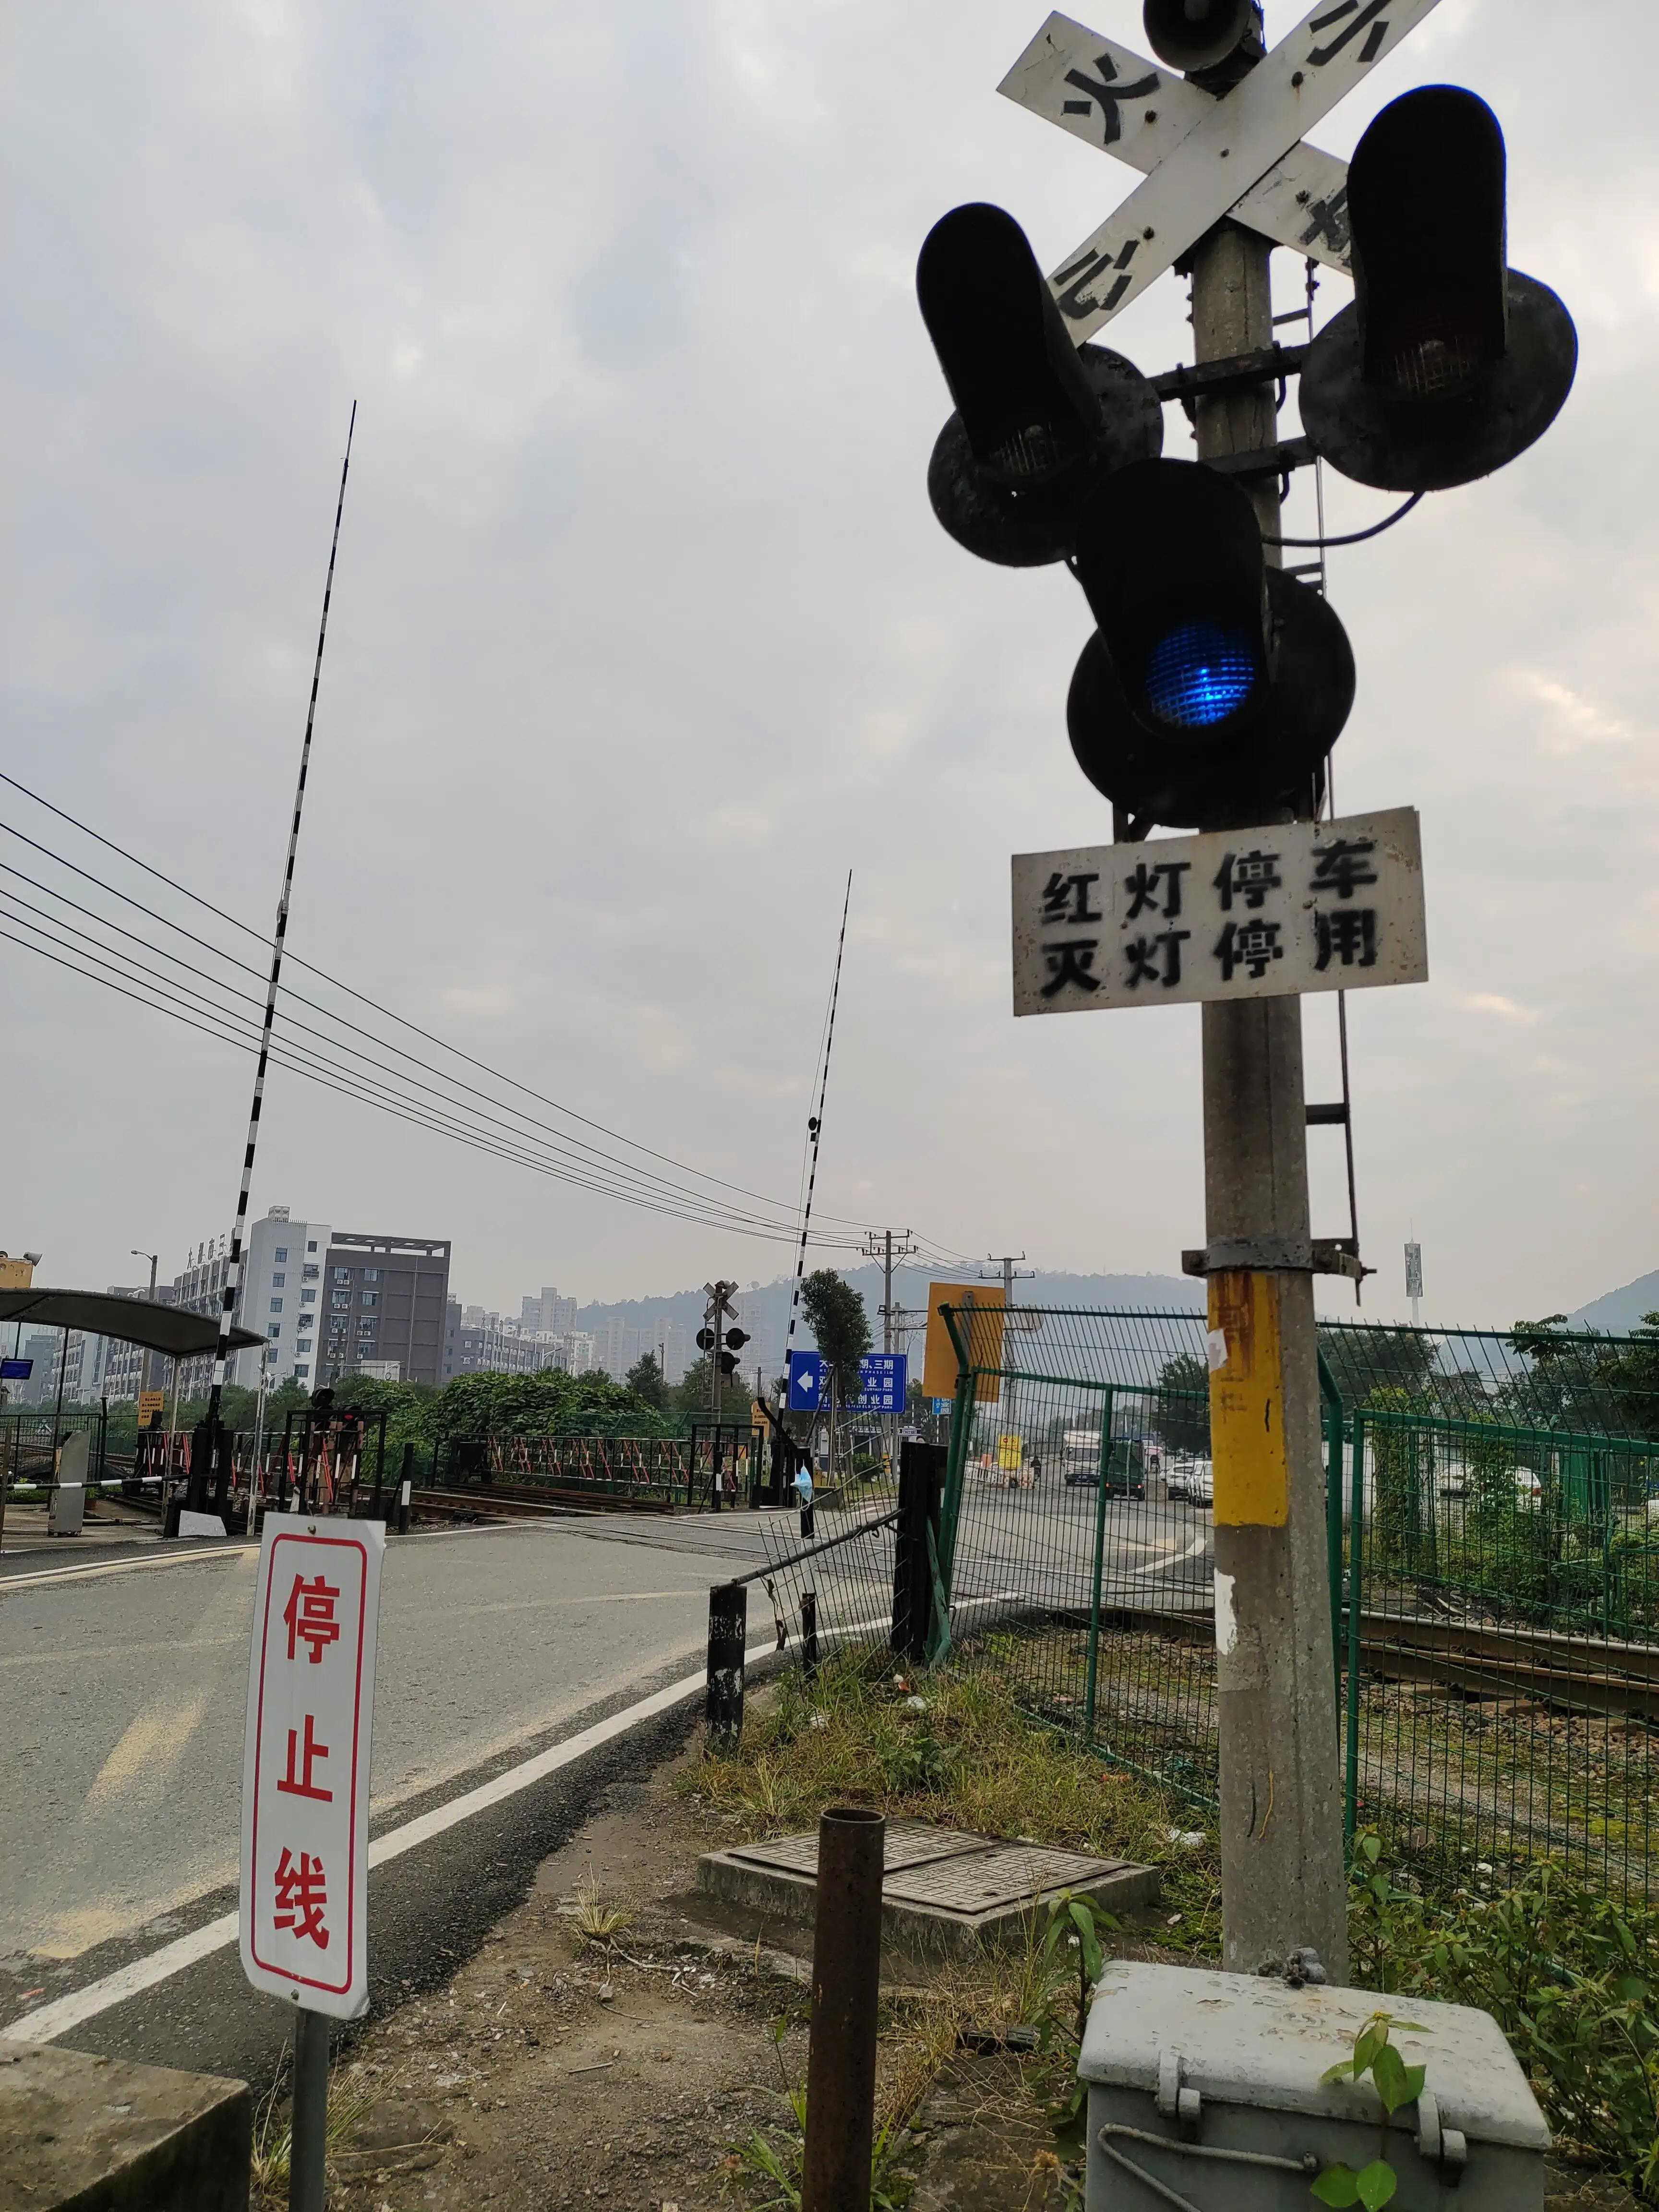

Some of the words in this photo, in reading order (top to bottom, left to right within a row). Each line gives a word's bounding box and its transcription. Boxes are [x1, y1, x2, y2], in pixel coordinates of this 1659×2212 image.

[1042, 839, 1378, 925] 红灯停车
[1041, 908, 1378, 997] 灭灯停用
[273, 1574, 340, 1950] 停止线
